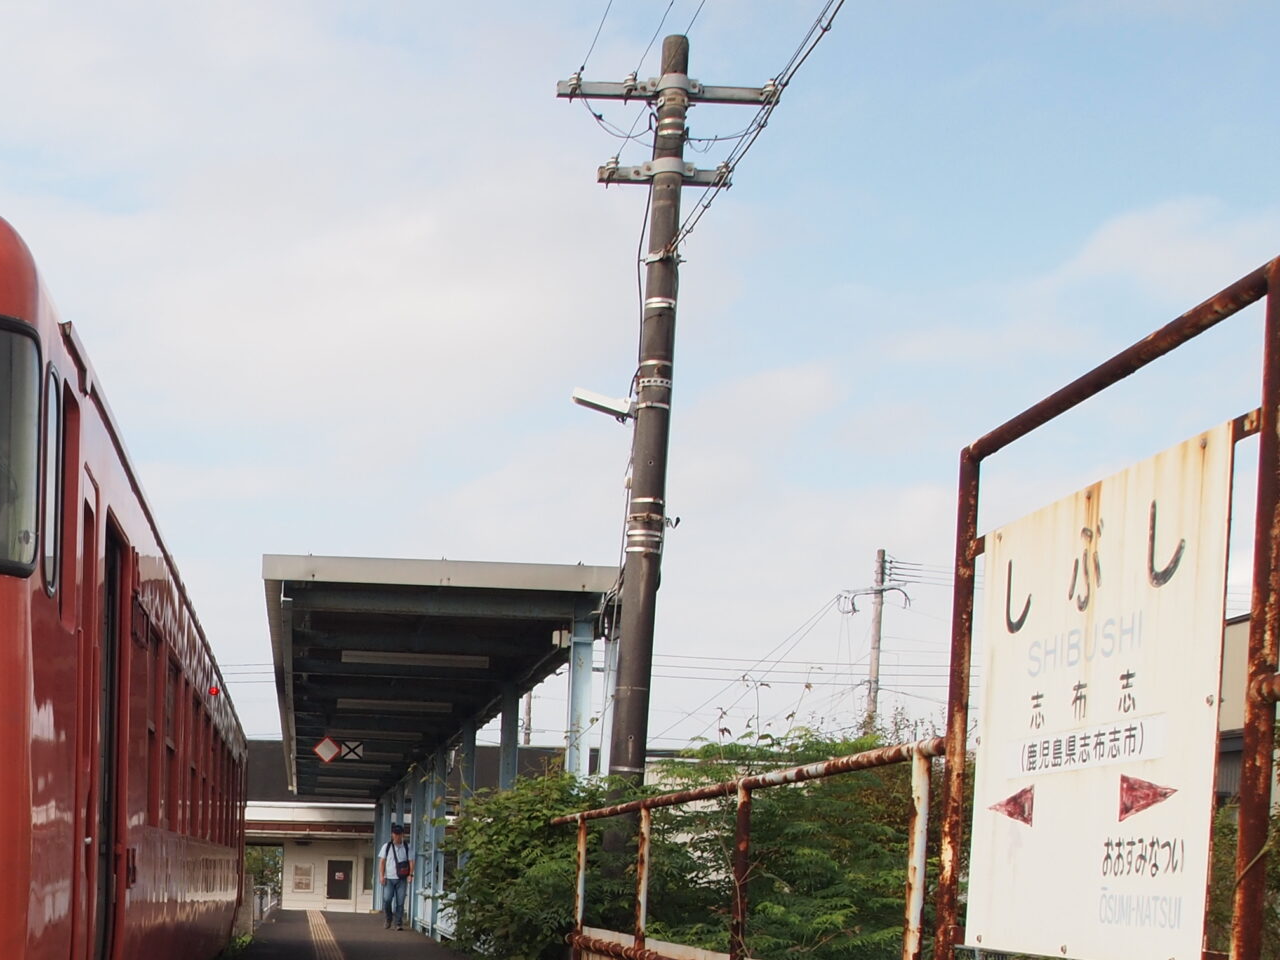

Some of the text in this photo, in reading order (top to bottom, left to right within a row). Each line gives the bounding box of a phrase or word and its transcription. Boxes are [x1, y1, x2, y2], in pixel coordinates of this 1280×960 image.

[1006, 500, 1186, 634] しぶし
[1027, 611, 1143, 677] SHIBUSHI
[1030, 669, 1136, 729] 志布志
[1021, 722, 1144, 772] (鹿児島県志布志市)
[1102, 836, 1184, 877] おおすみなつい
